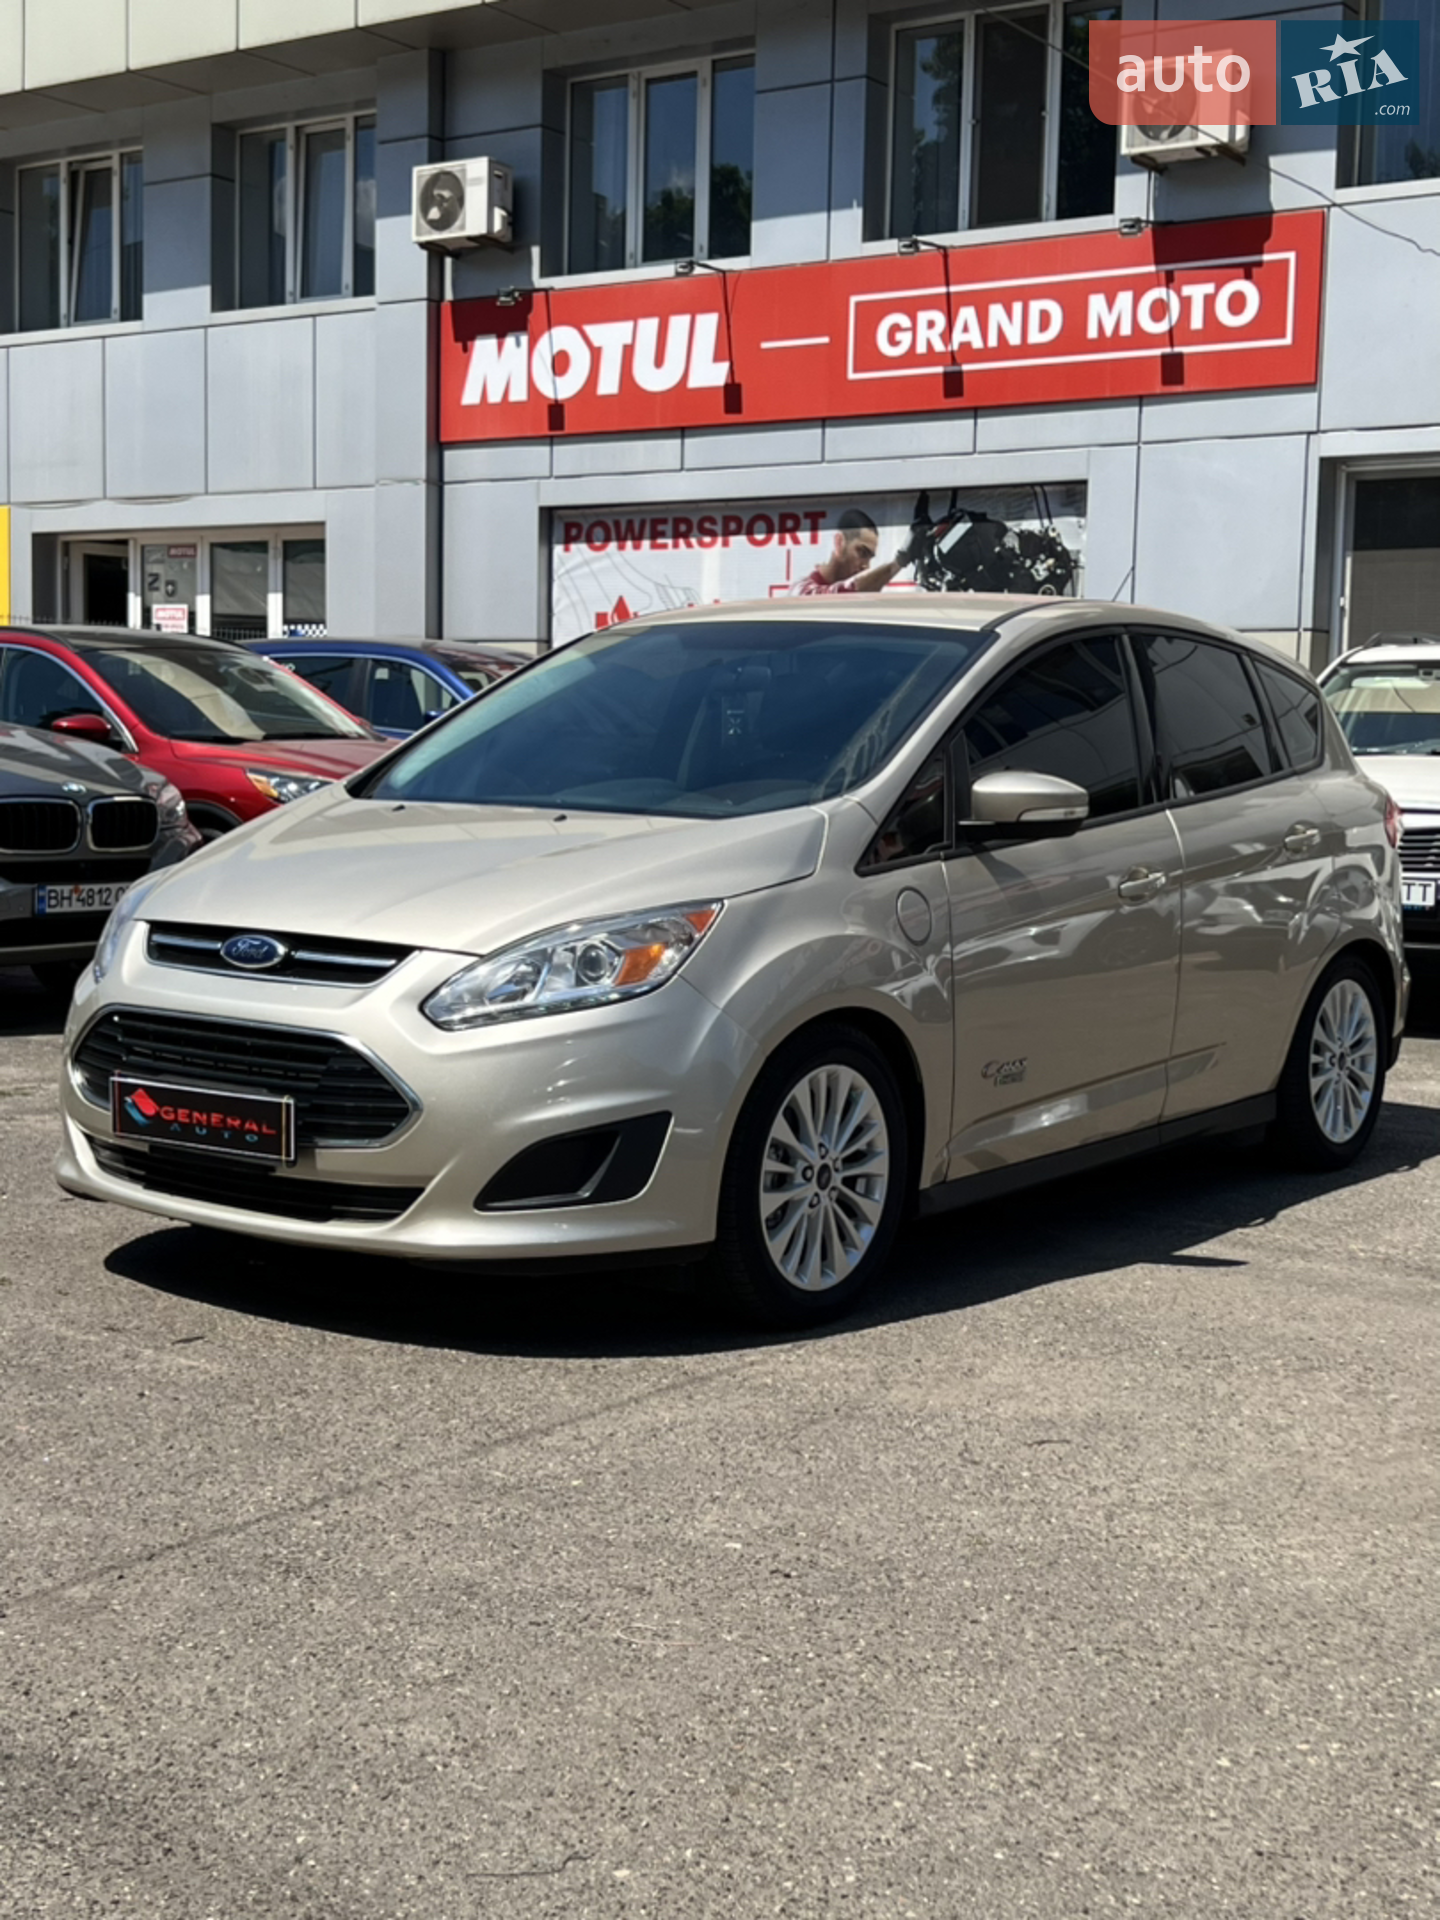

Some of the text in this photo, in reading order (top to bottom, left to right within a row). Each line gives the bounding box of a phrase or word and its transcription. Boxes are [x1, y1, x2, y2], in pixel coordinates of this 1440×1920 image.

[460, 279, 1260, 405] MOTUL GRAND MOTO
[562, 510, 827, 552] POWERSPORT
[232, 938, 270, 959] Ford
[159, 1105, 277, 1135] GENERAL
[169, 1122, 259, 1142] AUTO
